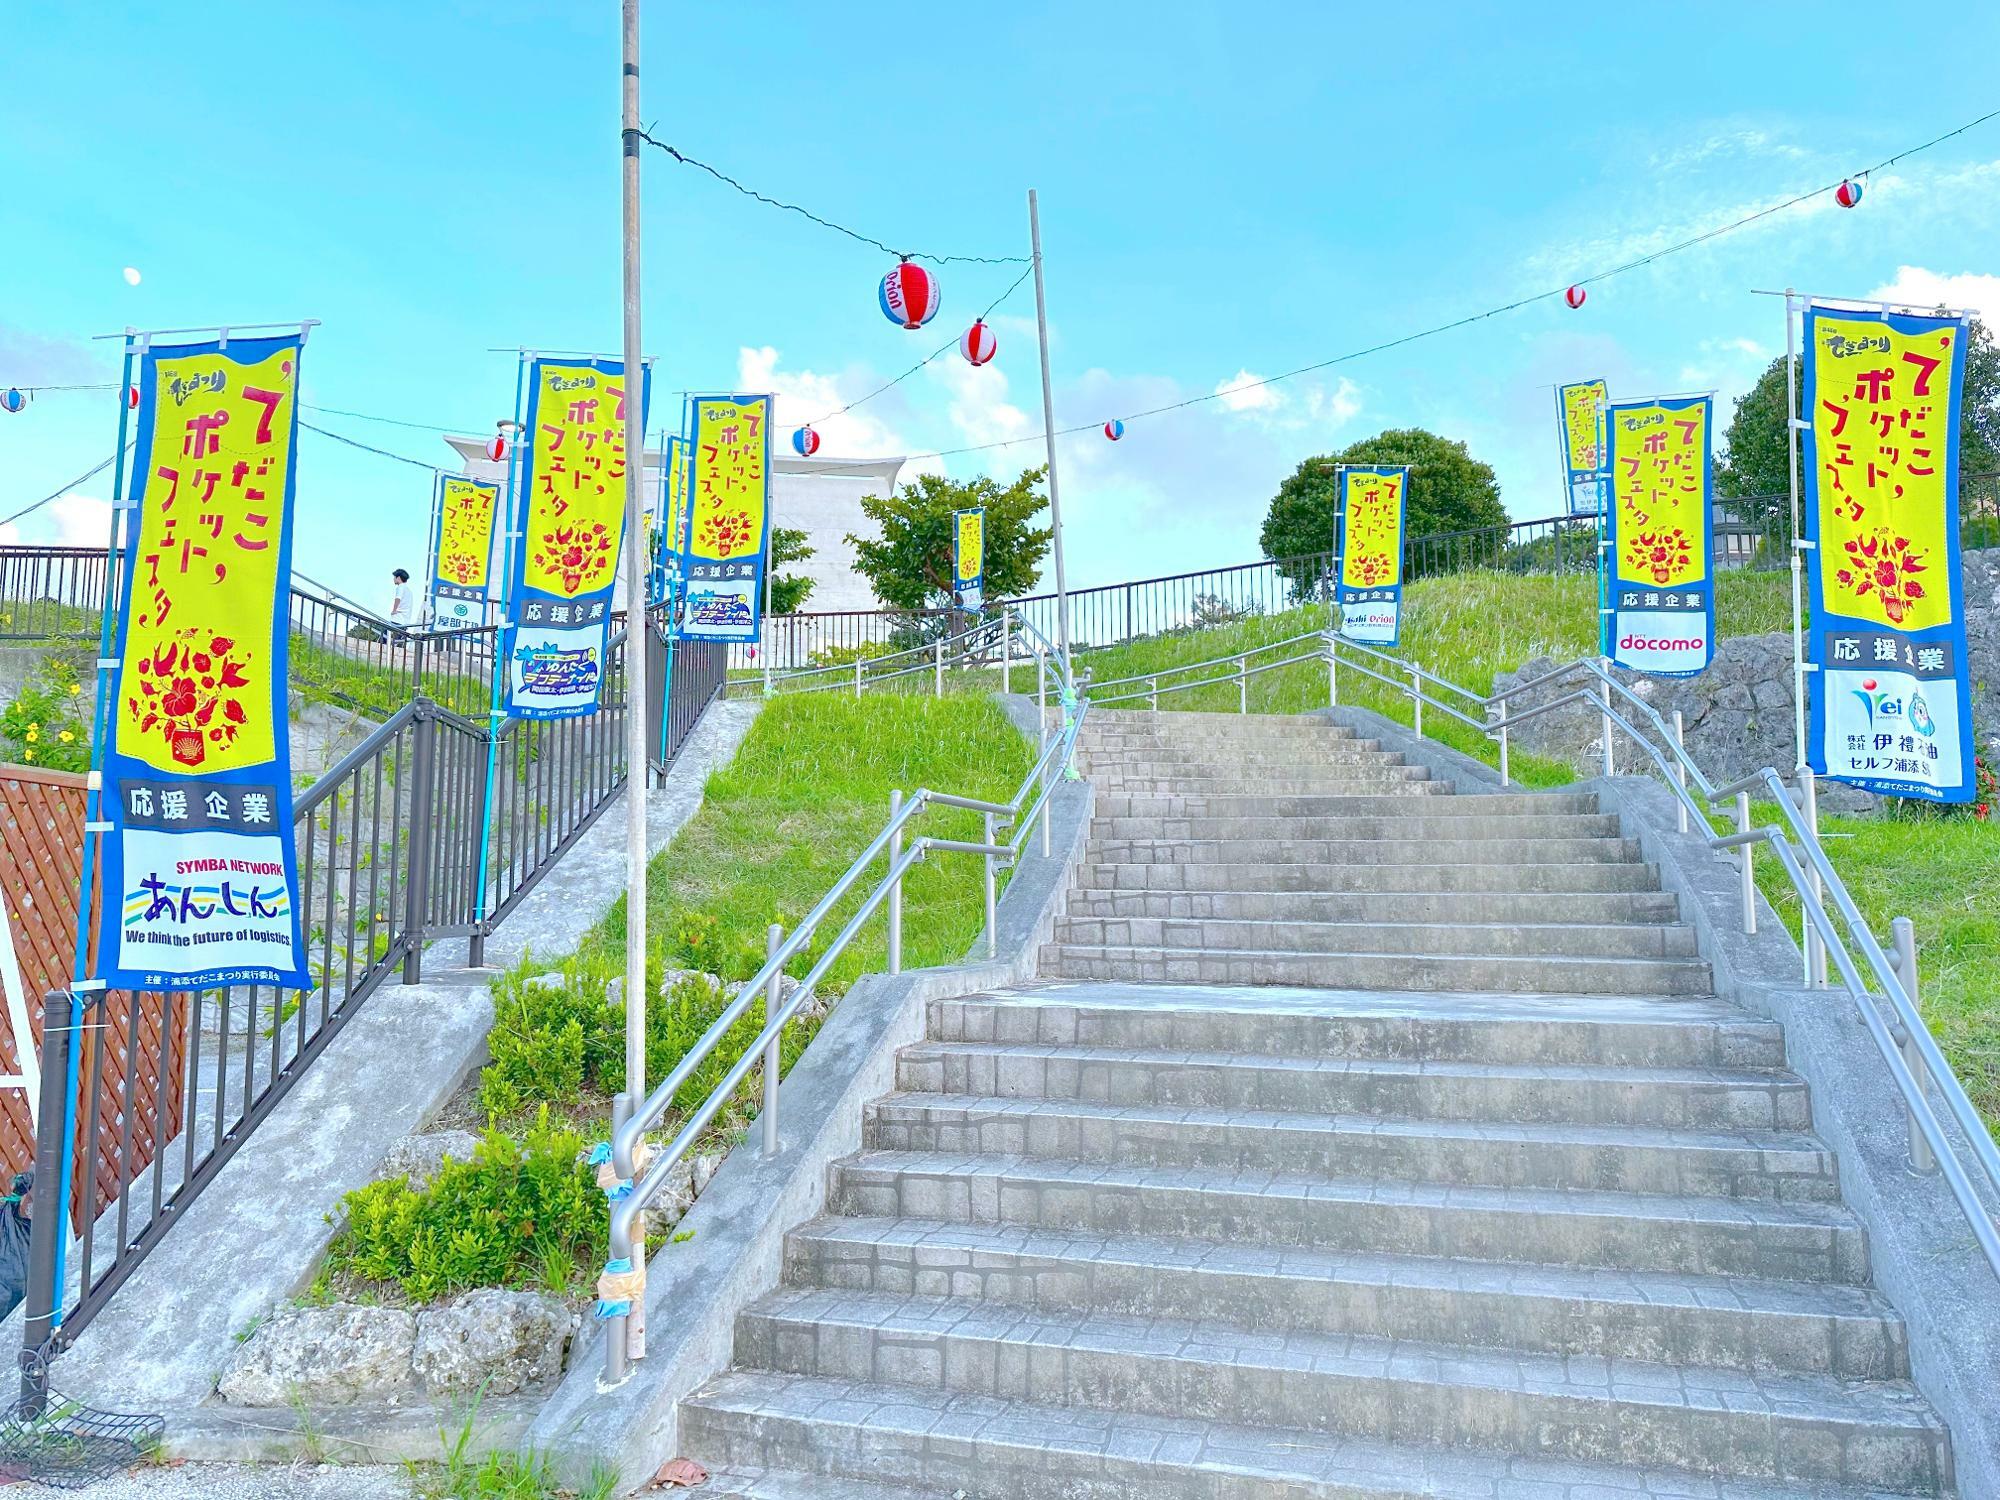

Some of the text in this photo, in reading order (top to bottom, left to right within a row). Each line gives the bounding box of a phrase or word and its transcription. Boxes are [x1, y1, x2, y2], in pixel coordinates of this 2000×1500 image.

[886, 271, 902, 309] Orion
[1854, 367, 1900, 488] ポケット
[1900, 351, 1942, 476] てだこ
[231, 385, 285, 551] てだこ
[567, 398, 599, 490] ポケット
[721, 425, 744, 490] ポケット
[743, 414, 761, 479] てだこ
[1643, 431, 1674, 504] ポケット
[1673, 420, 1698, 492] てだこ
[1822, 399, 1865, 522] フェスタ
[181, 409, 230, 574] ポケット
[538, 424, 569, 518] フェスタ
[700, 444, 723, 509] フェスタ
[1619, 456, 1650, 527] フェスタ
[445, 506, 459, 549] フェスタ
[459, 497, 475, 538] ポケット
[476, 493, 493, 536] てだこ
[1349, 503, 1365, 551] フェスタ
[1364, 489, 1383, 537] ポケット
[1382, 482, 1398, 530] てだこ
[145, 466, 180, 628] フェスタ
[692, 564, 754, 577] 応援企業
[526, 602, 605, 624] 応援企業
[1345, 590, 1395, 602] 応援企業
[1369, 613, 1395, 624] Orion
[1622, 592, 1701, 607] 応援企業
[1620, 634, 1703, 650] docomo
[130, 787, 271, 824] 応援企業
[176, 858, 284, 877] SYMBA NETWORK
[140, 873, 278, 923] あんしん
[126, 929, 292, 947] We think the future of logistics.
